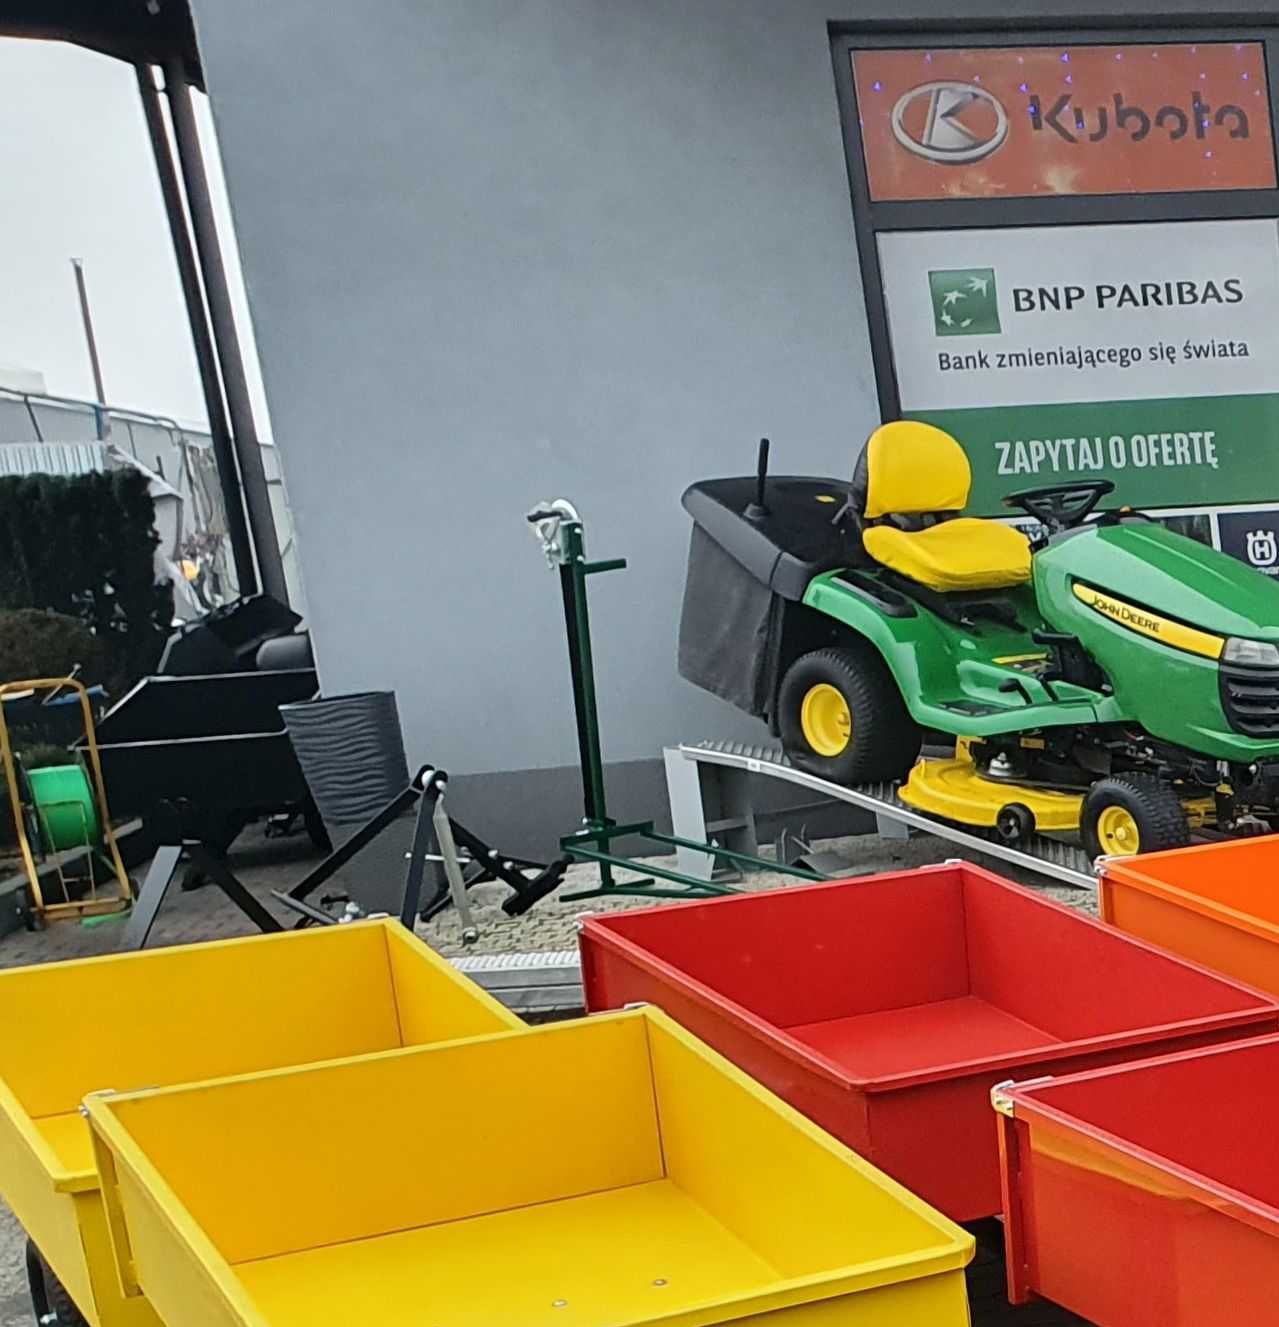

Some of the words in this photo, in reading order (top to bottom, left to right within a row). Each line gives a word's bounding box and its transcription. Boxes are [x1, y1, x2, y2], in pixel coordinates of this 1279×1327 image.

[1030, 91, 1250, 144] Kubota
[1012, 286, 1086, 313] BNP
[1095, 279, 1244, 309] PARIBAS
[938, 349, 990, 372] Bank
[996, 345, 1143, 369] zmieniającego
[1148, 341, 1177, 364] się
[1183, 338, 1250, 360] świata
[994, 437, 1105, 475] ZAPYTAJ
[1108, 435, 1127, 469] O
[1130, 431, 1219, 469] OFERTĘ
[1093, 595, 1120, 617] JOHN
[1121, 606, 1160, 633] DEERE
